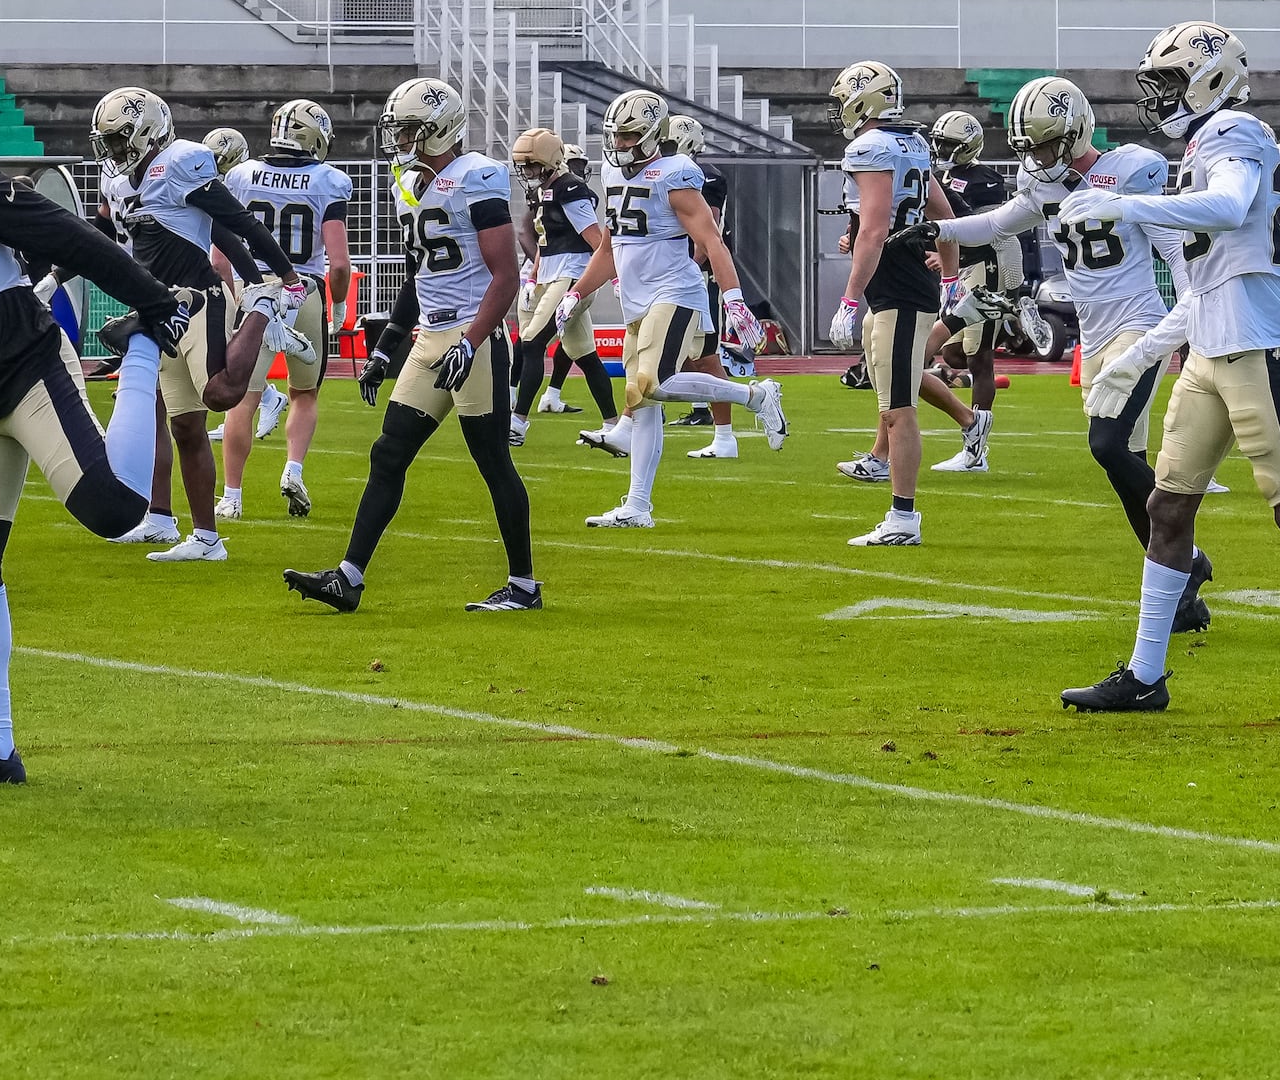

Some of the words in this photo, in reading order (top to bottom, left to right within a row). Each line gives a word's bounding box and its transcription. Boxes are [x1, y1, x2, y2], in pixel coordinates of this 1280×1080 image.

[251, 169, 311, 190] WERNER
[1089, 174, 1117, 185] ROUSES
[606, 186, 651, 237] 55
[1041, 201, 1125, 271] 38
